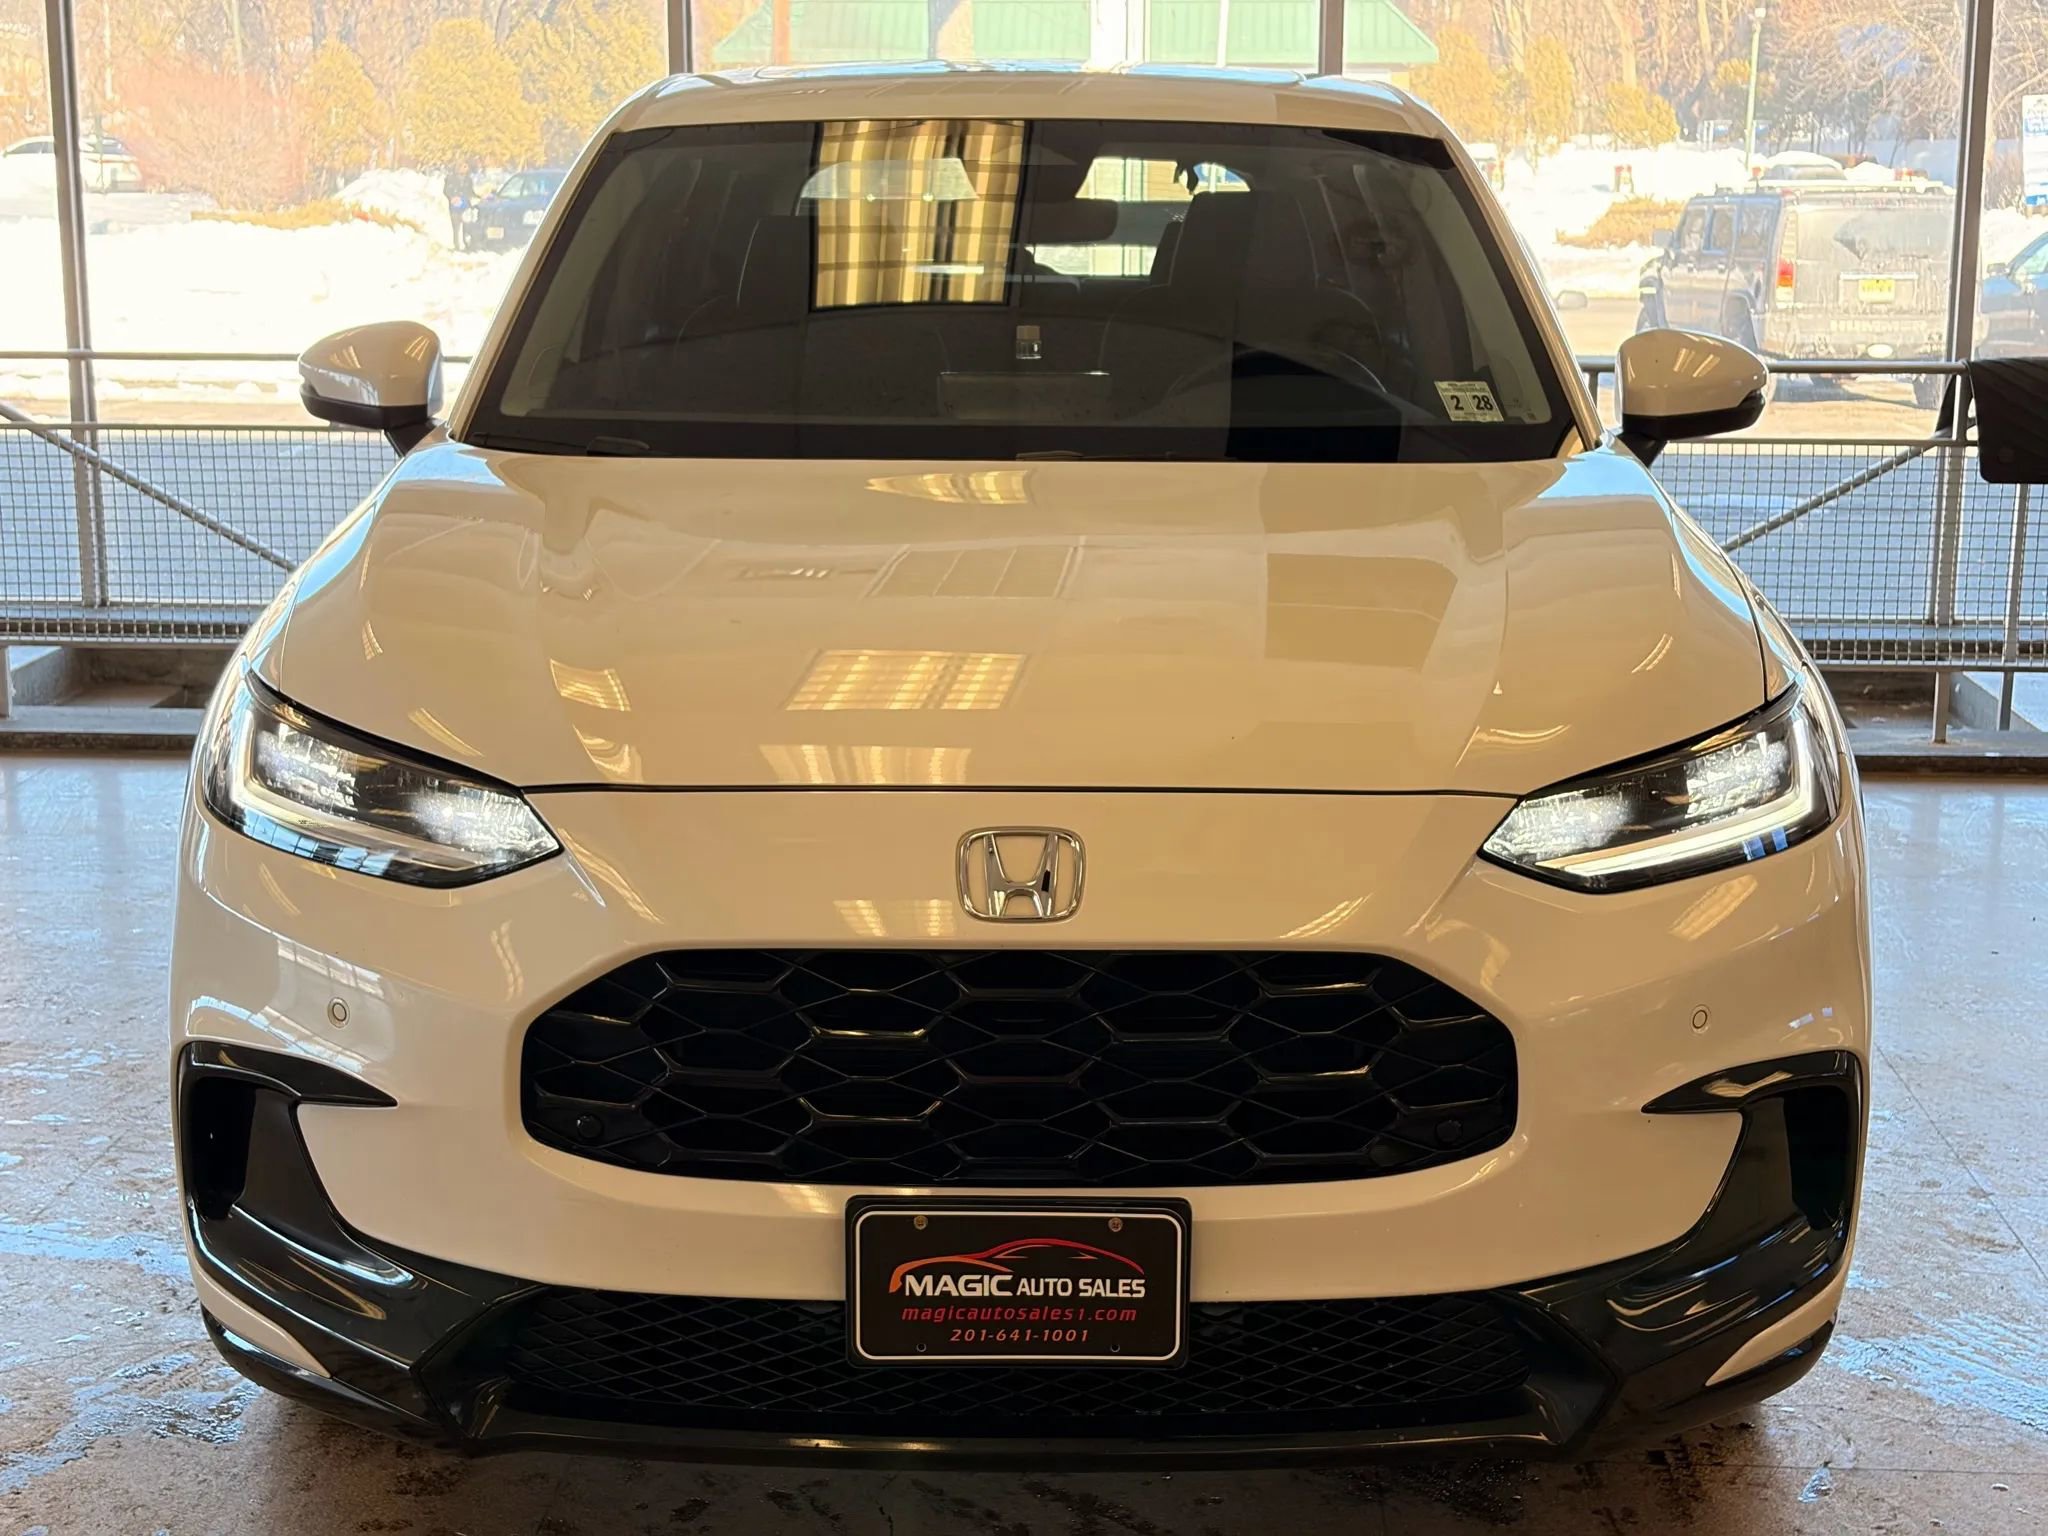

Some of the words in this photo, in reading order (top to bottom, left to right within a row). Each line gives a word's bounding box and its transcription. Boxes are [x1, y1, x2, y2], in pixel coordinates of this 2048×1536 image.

[1450, 395, 1464, 410] 2
[1472, 395, 1493, 410] 28
[905, 1274, 1014, 1297] MAGIC
[1016, 1278, 1073, 1297] AUTO
[1078, 1278, 1146, 1298] SALES
[901, 1305, 1137, 1323] magicautosales1.com
[949, 1329, 1089, 1342] 201-641-1001
